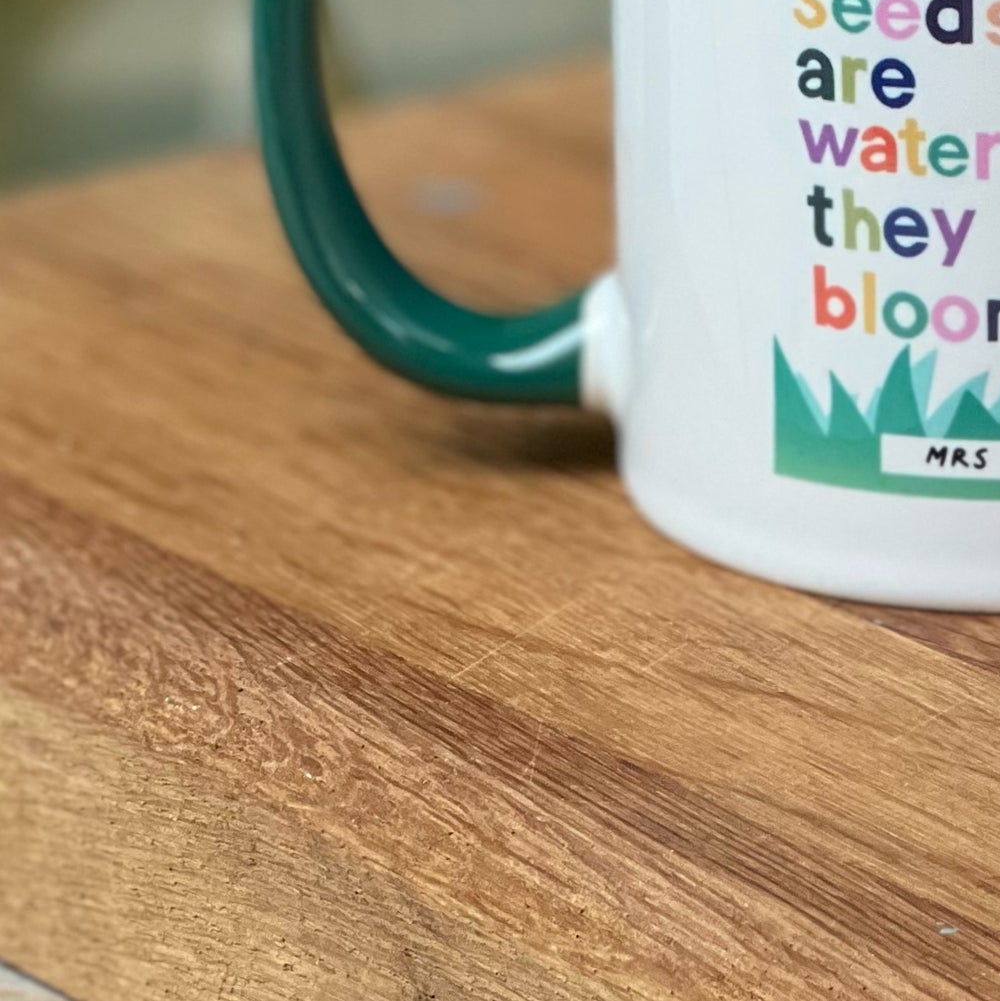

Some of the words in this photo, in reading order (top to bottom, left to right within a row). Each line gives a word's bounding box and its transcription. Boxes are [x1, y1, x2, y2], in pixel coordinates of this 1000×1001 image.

[796, 48, 916, 108] are
[806, 185, 976, 267] they
[925, 445, 988, 470] MRS
